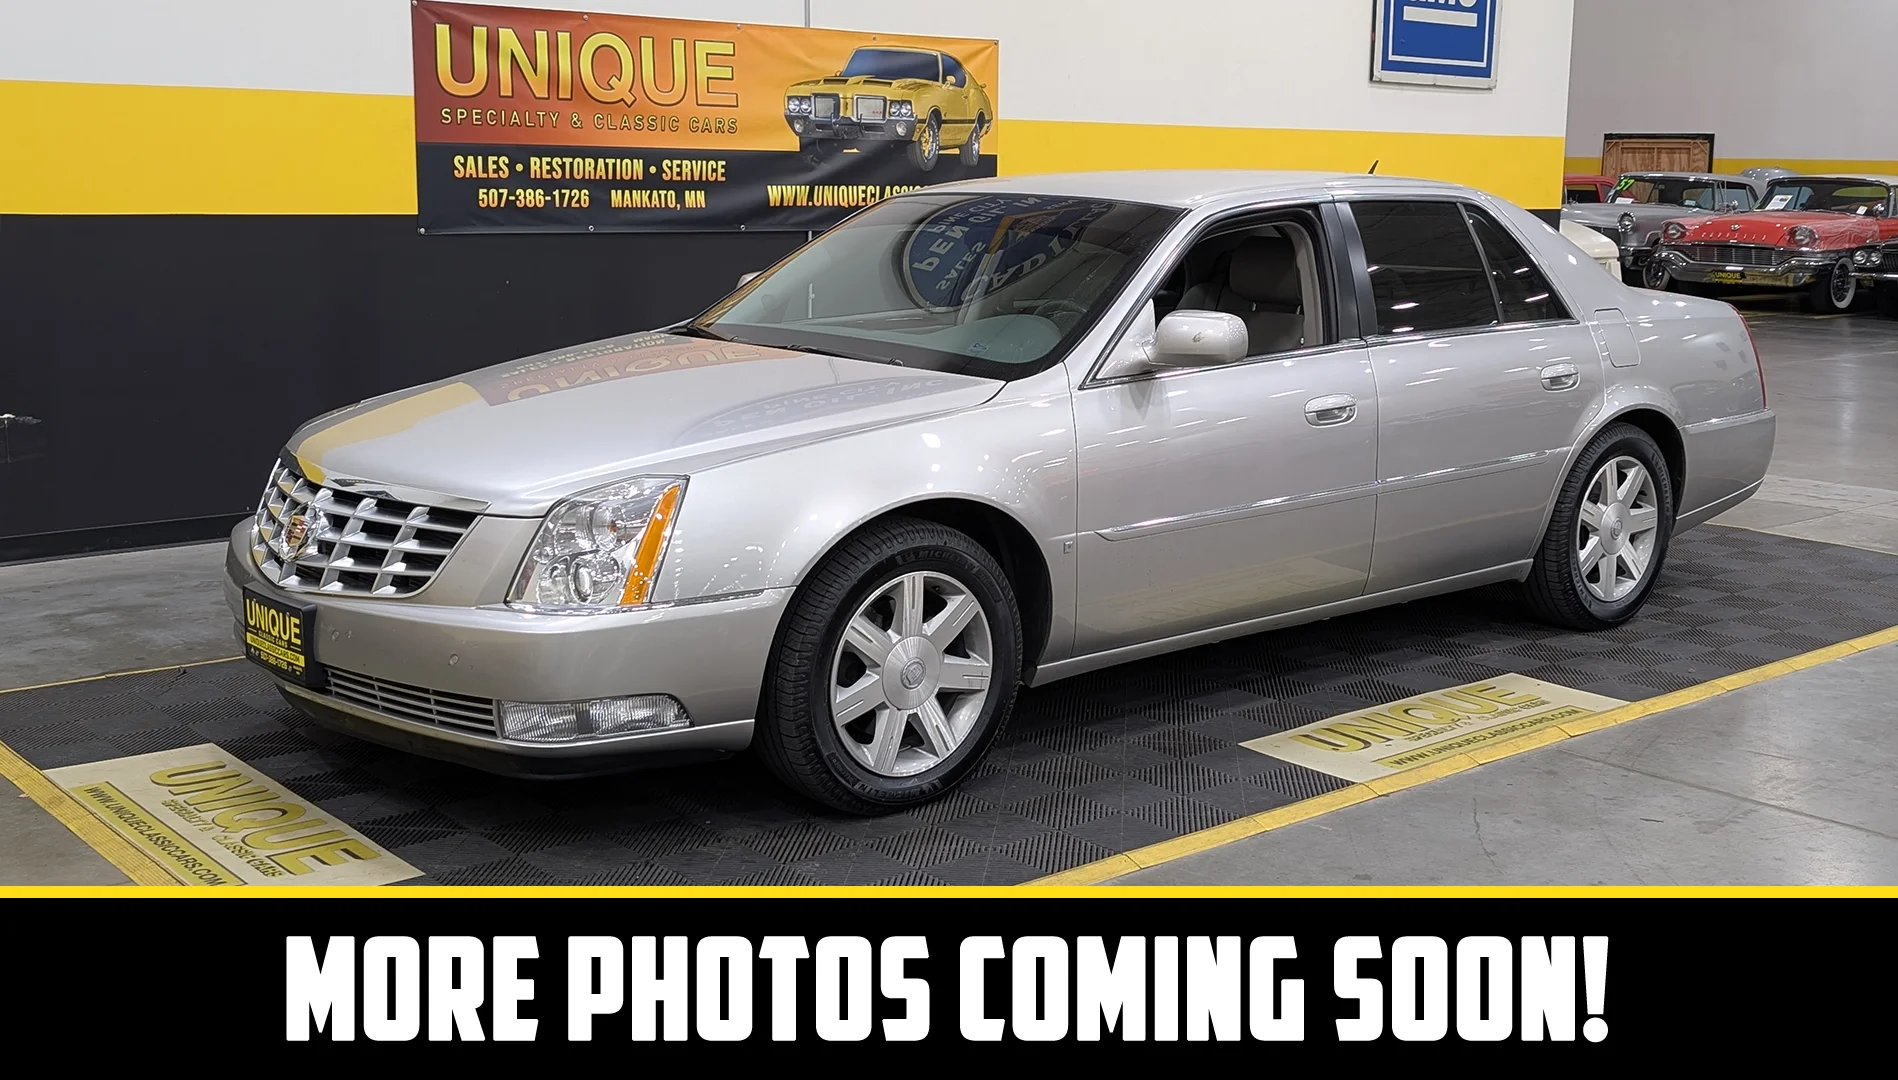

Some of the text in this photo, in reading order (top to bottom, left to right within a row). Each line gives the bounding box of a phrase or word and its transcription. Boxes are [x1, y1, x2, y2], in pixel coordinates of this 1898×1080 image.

[434, 22, 739, 108] UNIQUE
[440, 107, 738, 134] SPECIALTY & CLASSIC CARS
[453, 155, 727, 182] SALES RESTORATION SERVICE
[478, 188, 706, 211] 507-386-1726 MANKATO, MN
[246, 598, 302, 646] UNIQUE
[1288, 683, 1543, 753] UNIQUE
[1388, 708, 1584, 767] WWW.UNIQUECLASSICCARS.COM
[84, 786, 228, 886] WWW.UNIQUECLASSICCARS.COM
[149, 759, 382, 876] UNIQUE
